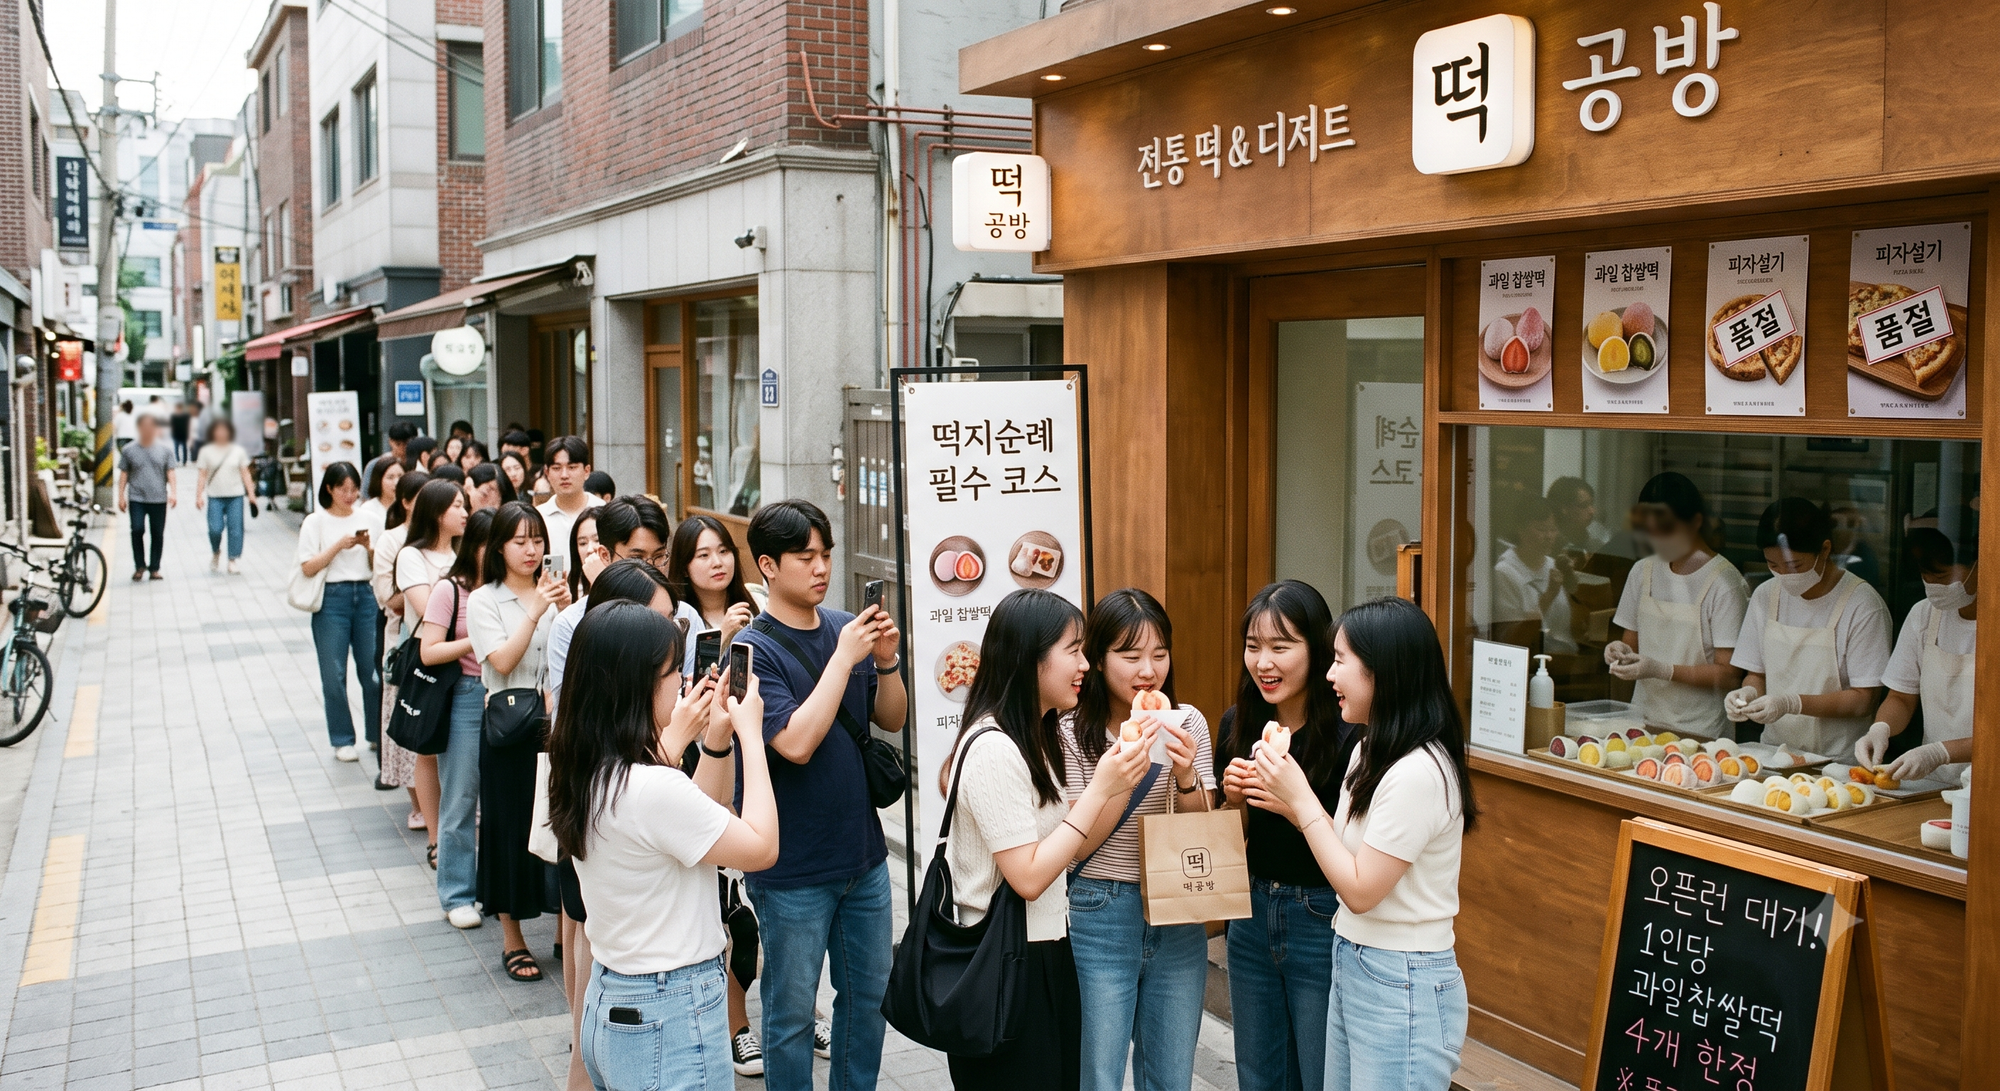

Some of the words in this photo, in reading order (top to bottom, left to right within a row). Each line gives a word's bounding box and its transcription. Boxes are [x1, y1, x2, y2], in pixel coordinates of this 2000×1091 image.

[1432, 42, 1490, 144] 떡
[1562, 1, 1739, 132] 공방
[1137, 131, 1190, 189] 전통
[1195, 123, 1222, 179] 떡
[1228, 124, 1253, 168] &
[1258, 103, 1357, 168] 디저트
[990, 164, 1021, 207] 떡
[984, 212, 1030, 239] 공방
[1594, 264, 1618, 284] 과일
[1621, 261, 1659, 283] 찹쌀떡
[1728, 251, 1785, 275] 피자설기
[1875, 239, 1942, 266] 피자설기
[1488, 271, 1510, 290] 과일
[1512, 269, 1546, 289] 찹쌀떡
[1728, 303, 1782, 352] 품절
[1875, 300, 1936, 350] 품절
[932, 417, 1053, 457] 떡지순례
[929, 465, 991, 502] 필수
[1000, 464, 1062, 495] 코스
[930, 608, 953, 623] 과일
[957, 605, 991, 621] 찹쌀떡
[936, 714, 963, 730] 피자
[1187, 852, 1204, 873] 떡
[1644, 866, 1728, 926] 오픈런
[1744, 898, 1824, 950] 대기!
[1640, 922, 1714, 975] 1인당
[1628, 969, 1783, 1053] 과일찹쌀떡
[1625, 1017, 1680, 1068] 4개
[1697, 1038, 1757, 1091] 한정
